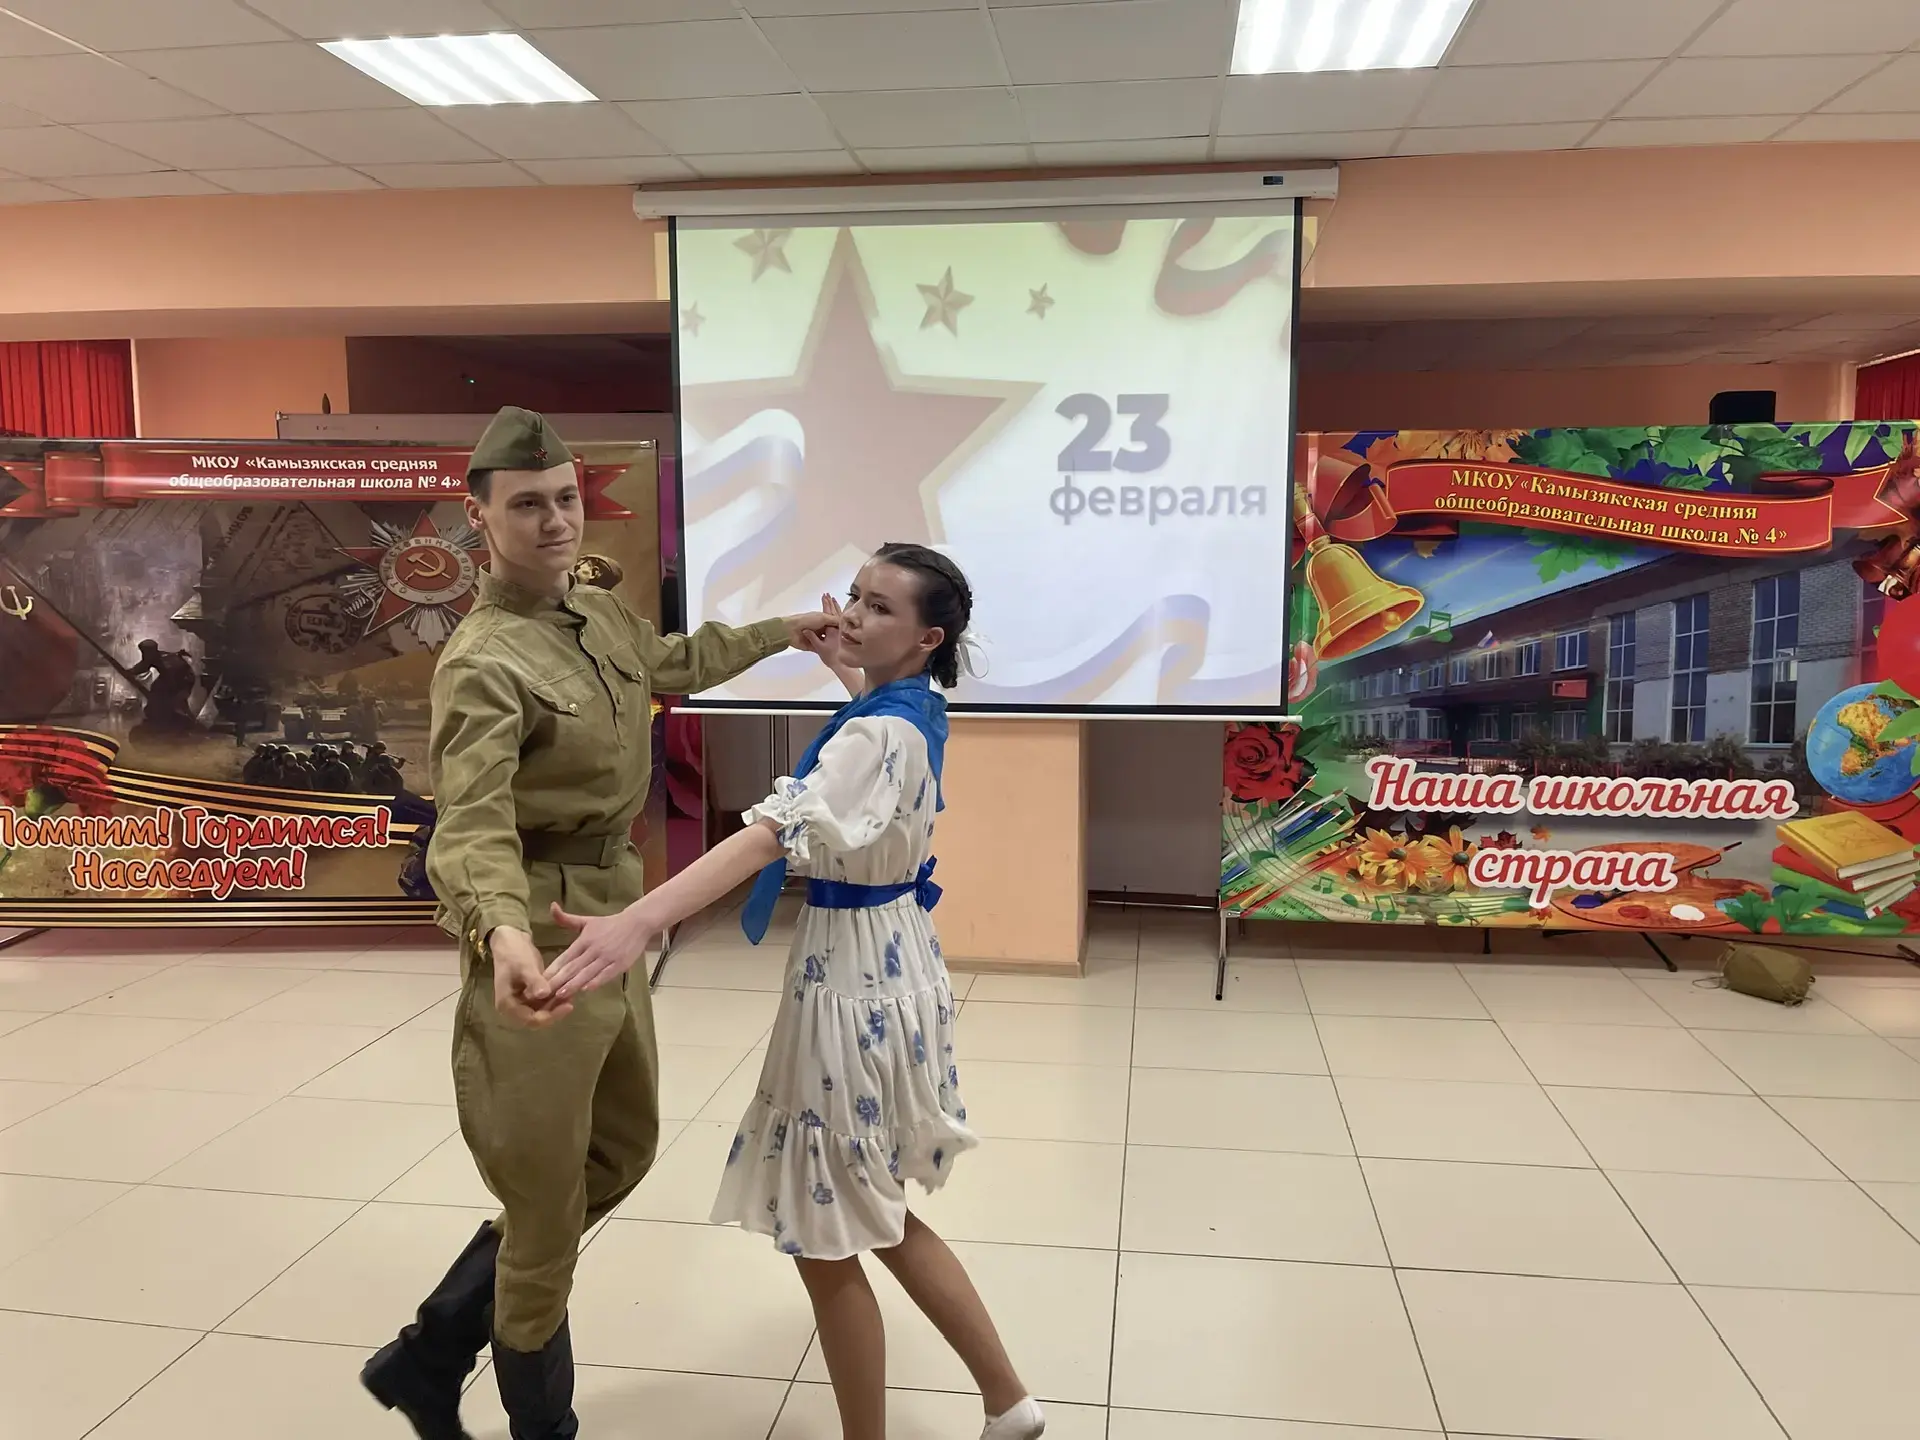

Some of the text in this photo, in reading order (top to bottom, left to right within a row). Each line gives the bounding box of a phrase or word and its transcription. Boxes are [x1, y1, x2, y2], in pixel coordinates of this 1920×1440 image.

[1054, 392, 1172, 474] 23
[169, 474, 461, 490] общеобразовательная школа № 4»
[192, 456, 438, 471] МКОУ «Камызякская средняя
[1050, 475, 1267, 526] февраля
[1434, 493, 1787, 545] общеобразовательная школа № 4»
[1451, 469, 1758, 520] МКОУ «Камызякская средняя
[1370, 761, 1795, 816] Наша школьная
[181, 807, 391, 858] Гордимся!
[72, 851, 305, 898] Наследуем!
[1474, 851, 1674, 904] страна
